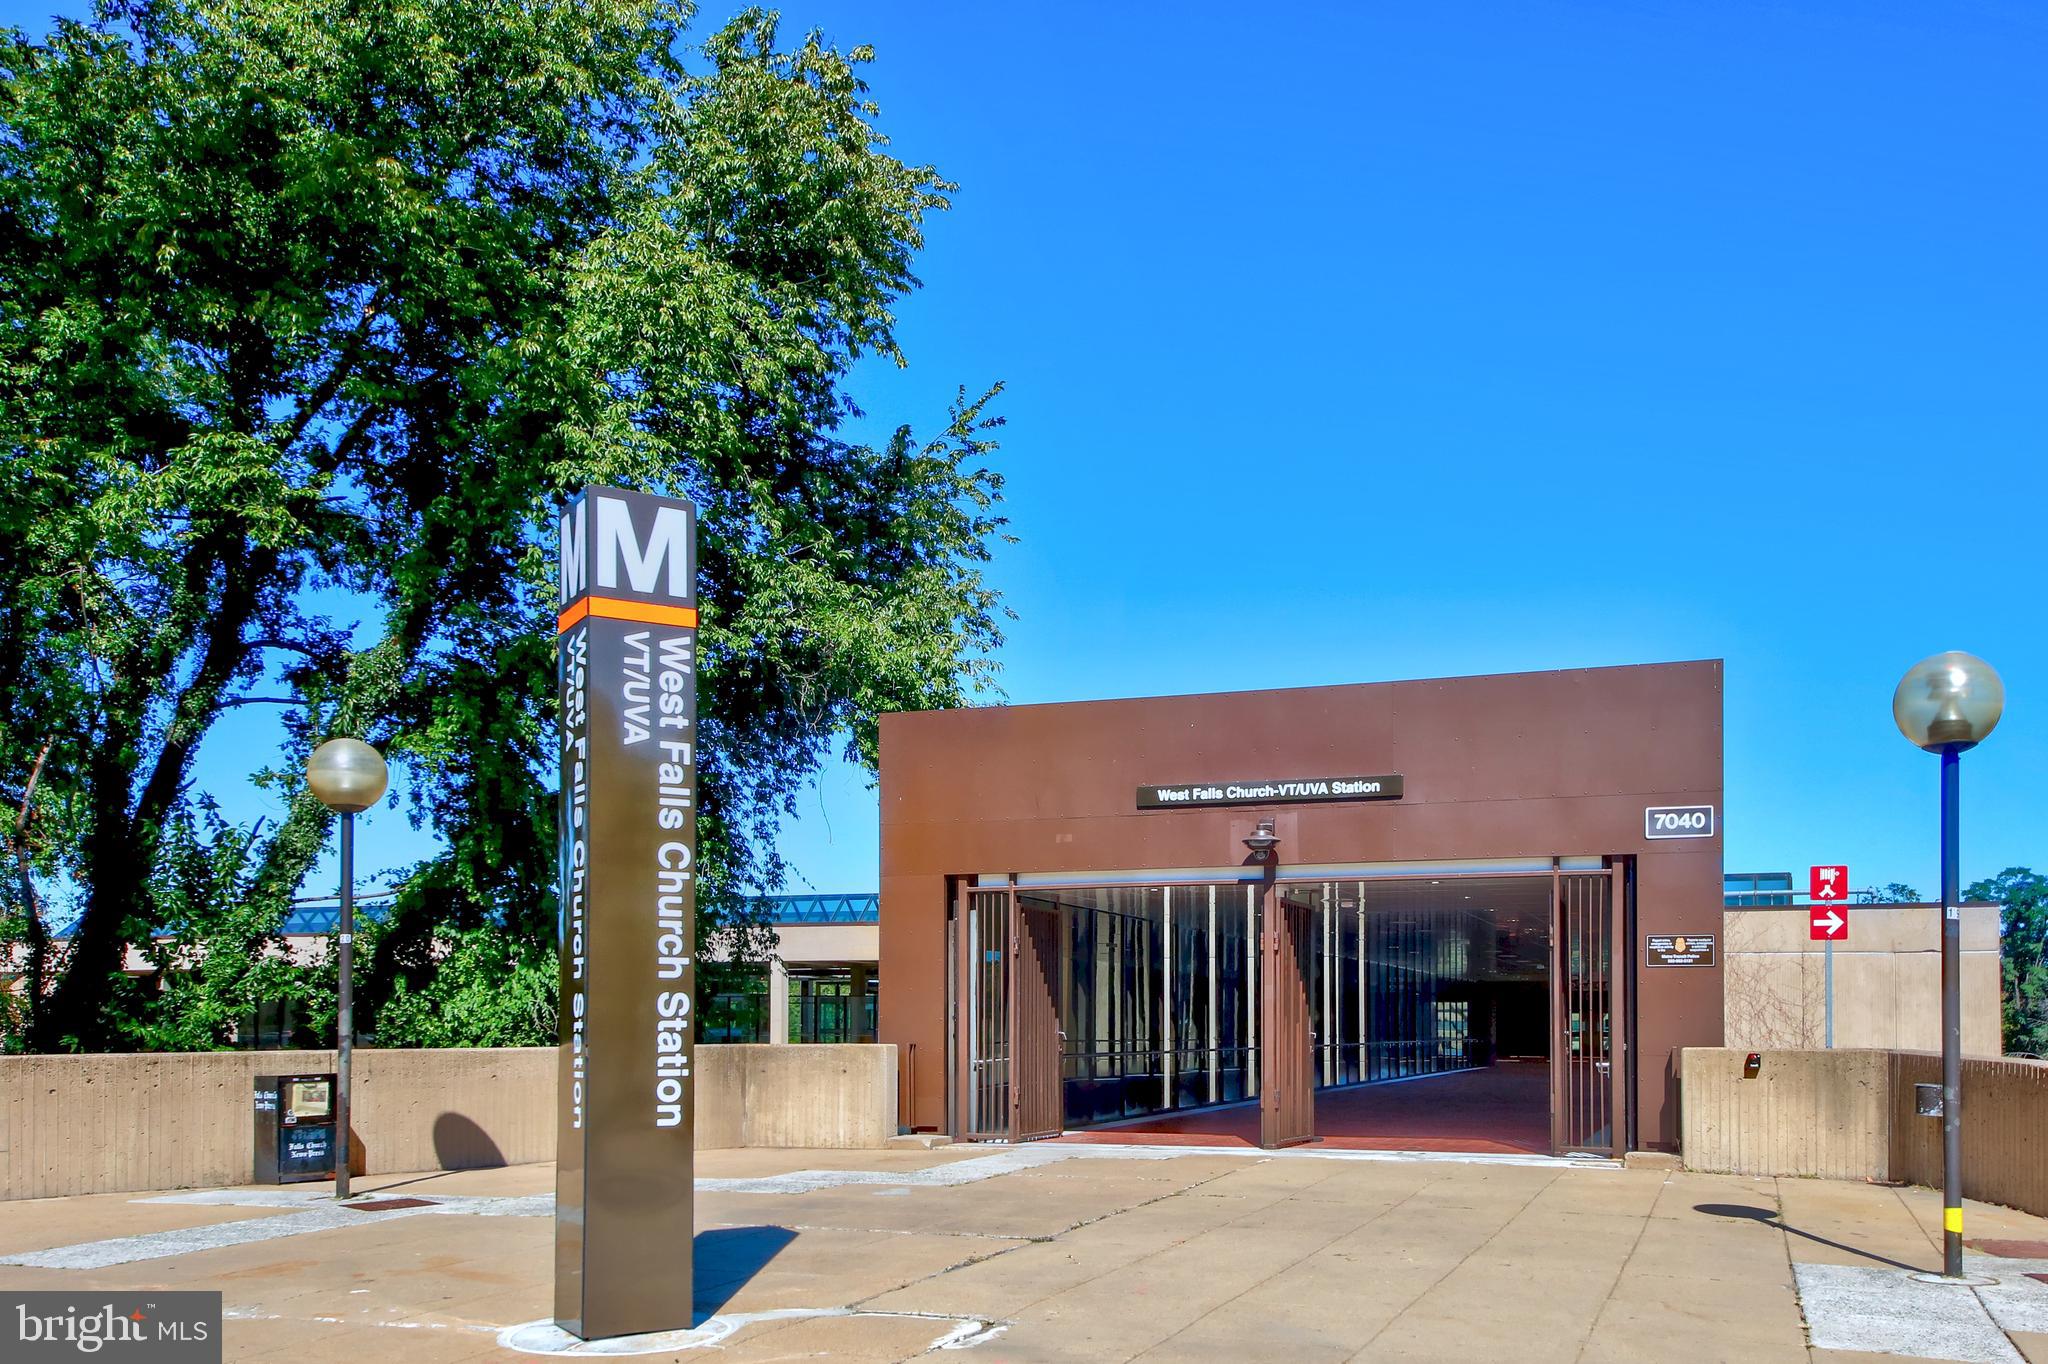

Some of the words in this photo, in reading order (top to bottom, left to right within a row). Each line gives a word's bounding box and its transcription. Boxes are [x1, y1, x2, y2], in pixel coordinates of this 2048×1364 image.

[561, 498, 587, 605] M
[597, 496, 688, 598] M
[565, 634, 576, 752] VT/UVA
[575, 627, 587, 726] West
[623, 631, 651, 746] VT/UVA
[658, 636, 691, 730] West
[573, 736, 586, 829] Falls
[658, 741, 692, 830] Falls
[1157, 788, 1190, 802] West
[1192, 786, 1224, 800] Falls
[1226, 782, 1329, 799] Church-VT/UVA
[1331, 780, 1381, 795] Station
[1654, 812, 1706, 830] 7040
[572, 839, 585, 979] Church
[656, 841, 692, 980] Church
[573, 992, 585, 1129] Station
[656, 991, 691, 1128] Station
